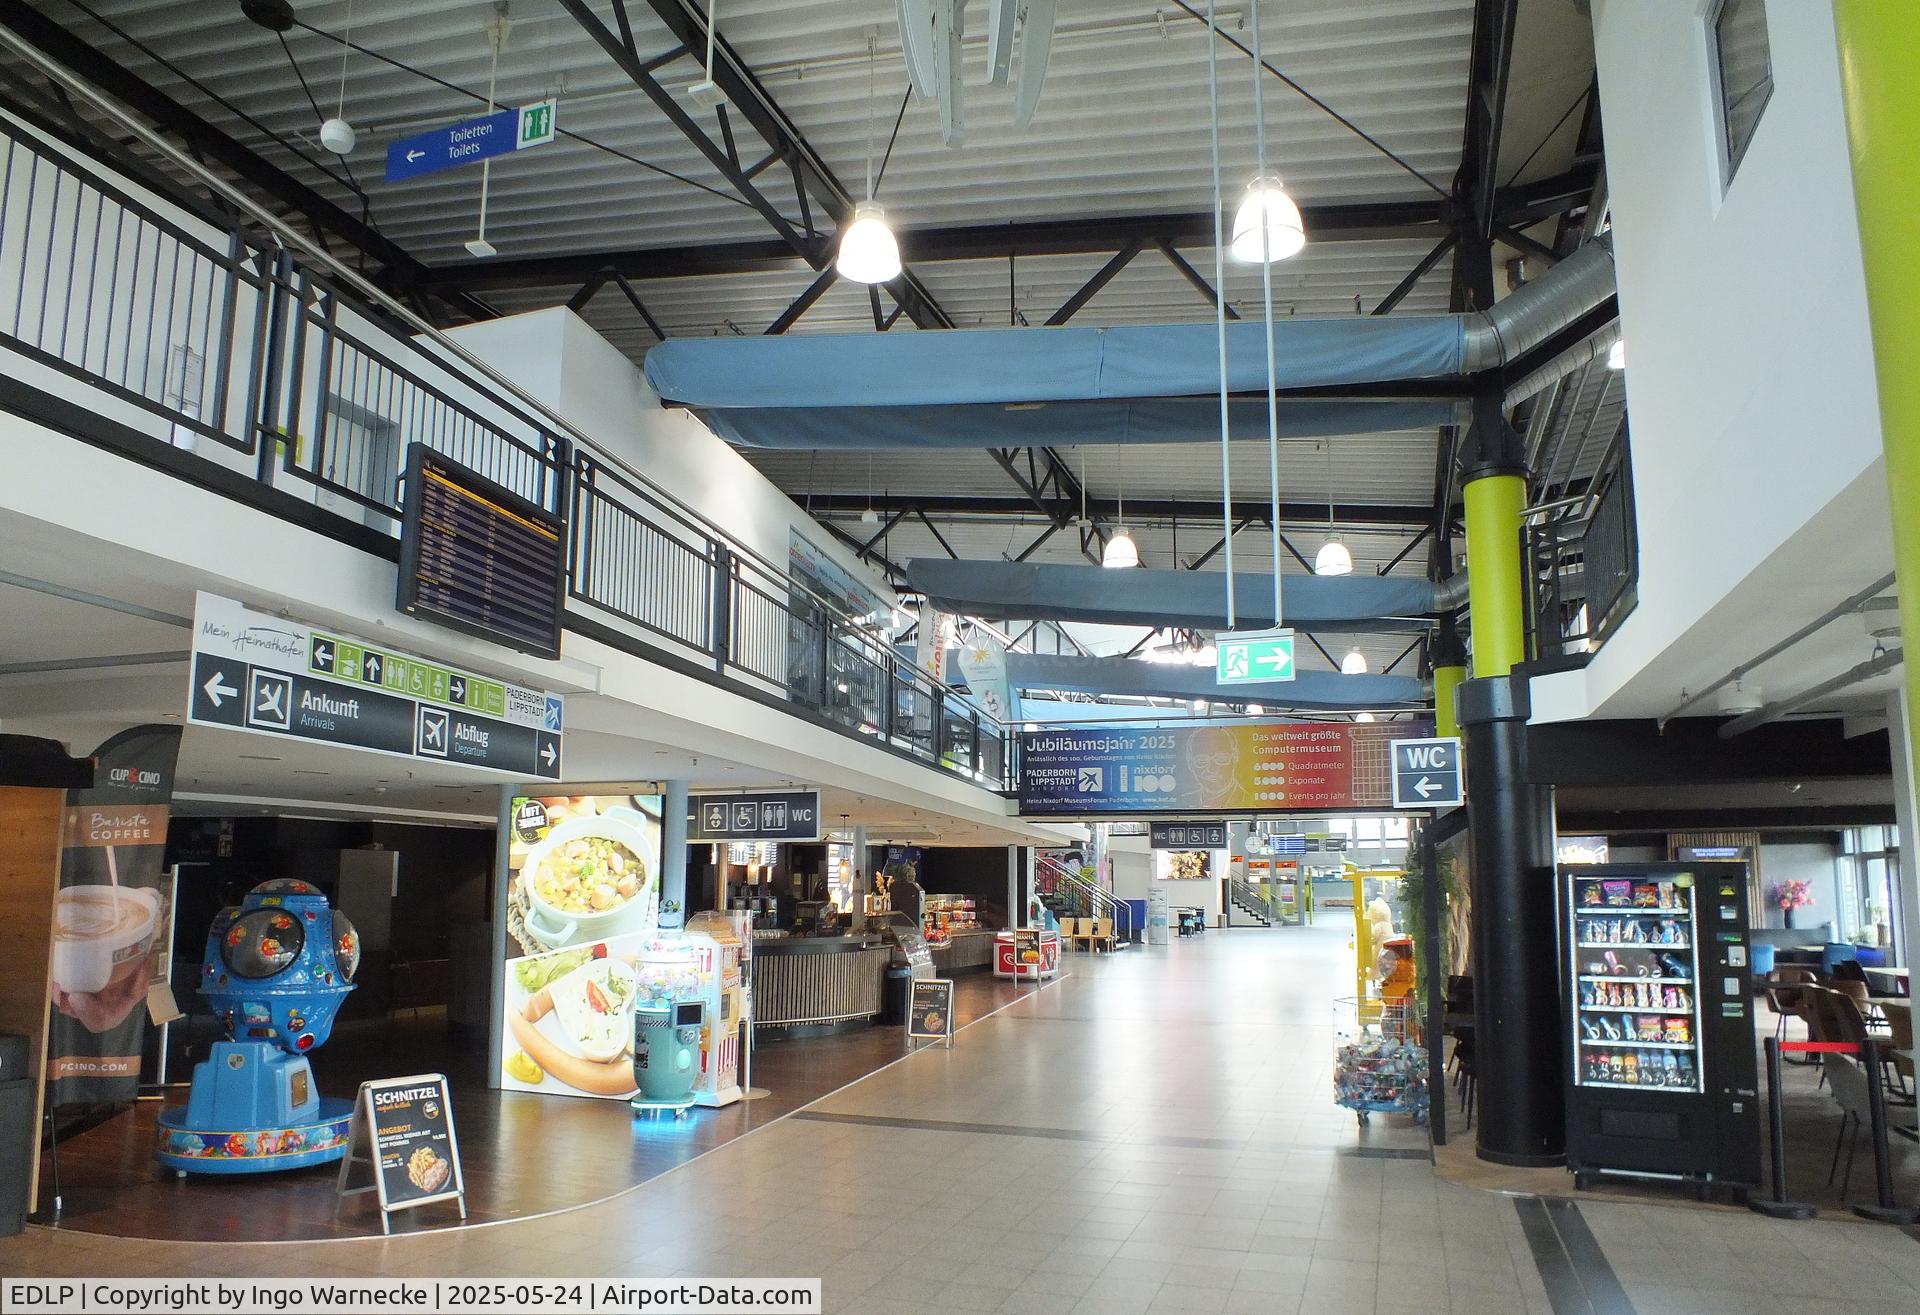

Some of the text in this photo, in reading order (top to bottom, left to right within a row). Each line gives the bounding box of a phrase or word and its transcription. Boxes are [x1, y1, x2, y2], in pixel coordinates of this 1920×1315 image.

[450, 123, 493, 144] Toiletten
[449, 143, 480, 159] Toilets
[202, 621, 304, 658] Mein Heimathafen
[302, 690, 360, 719] Ankunft
[506, 687, 545, 706] PADERBORN
[509, 699, 545, 718] LIPPSTADT
[301, 713, 336, 731] Arrivals
[455, 722, 490, 748] Abflug
[1252, 730, 1341, 742] Das weltweit größte
[454, 742, 487, 758] Departure
[1026, 735, 1176, 753] Jubiläumsjahr 2025
[1252, 745, 1342, 756] Computermuseum
[1406, 746, 1447, 769] WC
[1026, 769, 1077, 777] PADERBORN
[1134, 765, 1177, 775] nixdorf
[1288, 762, 1345, 771] Quadratmeter
[110, 767, 161, 785] CUP&CINO
[1030, 777, 1076, 786] LIPPSTADT
[1288, 776, 1326, 786] Exponate
[1289, 792, 1314, 801] Events
[1315, 793, 1329, 802] pro
[1330, 792, 1346, 800] Jahr
[91, 812, 150, 829] Barista
[792, 809, 812, 823] WC
[90, 829, 151, 841] COFFEE
[1153, 832, 1166, 840] WC
[375, 1087, 439, 1105] SCHNITZEL
[378, 1124, 411, 1135] ANGEBOT
